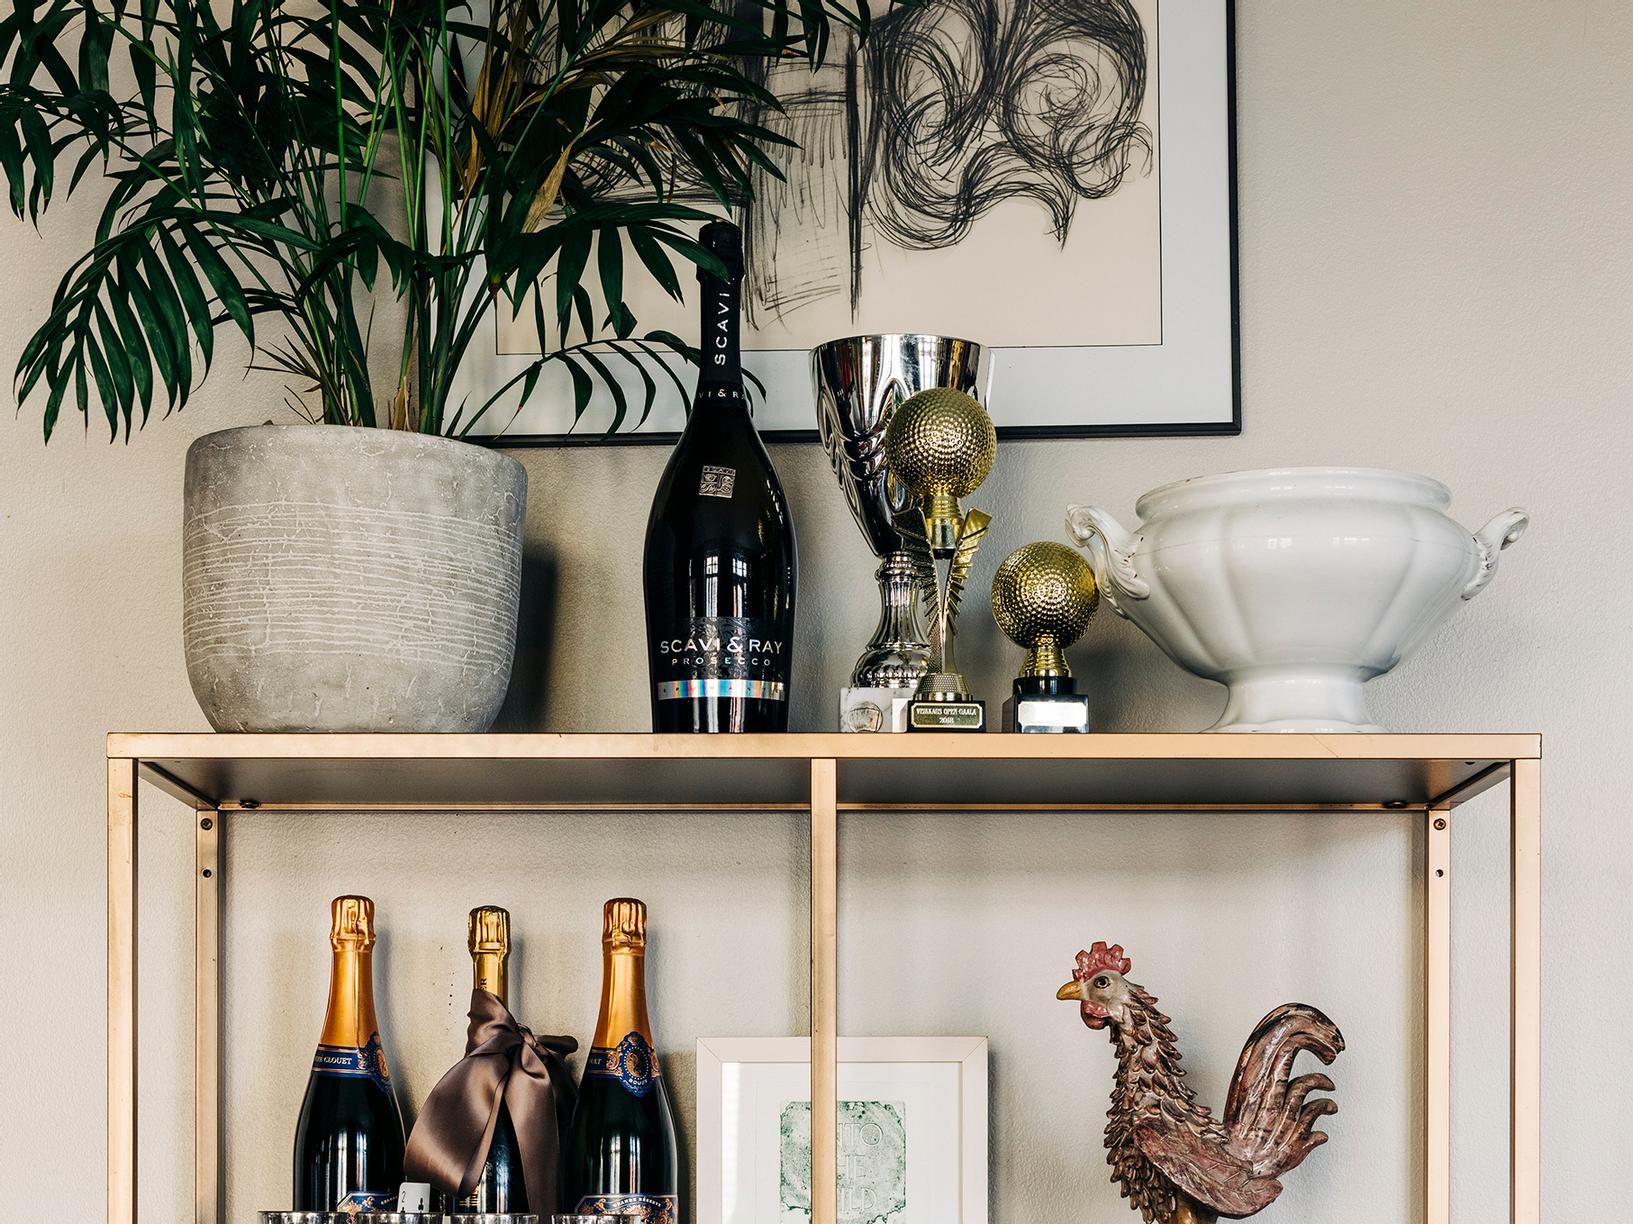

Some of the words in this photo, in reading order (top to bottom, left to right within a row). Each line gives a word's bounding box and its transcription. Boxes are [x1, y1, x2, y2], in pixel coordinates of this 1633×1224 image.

[714, 293, 730, 366] SCAVI
[660, 638, 720, 654] SCAVI
[726, 636, 743, 653] &
[749, 638, 783, 655] RAY
[671, 657, 771, 666] PROSECCO
[943, 707, 958, 715] OPEN
[323, 1056, 353, 1065] CLOUET
